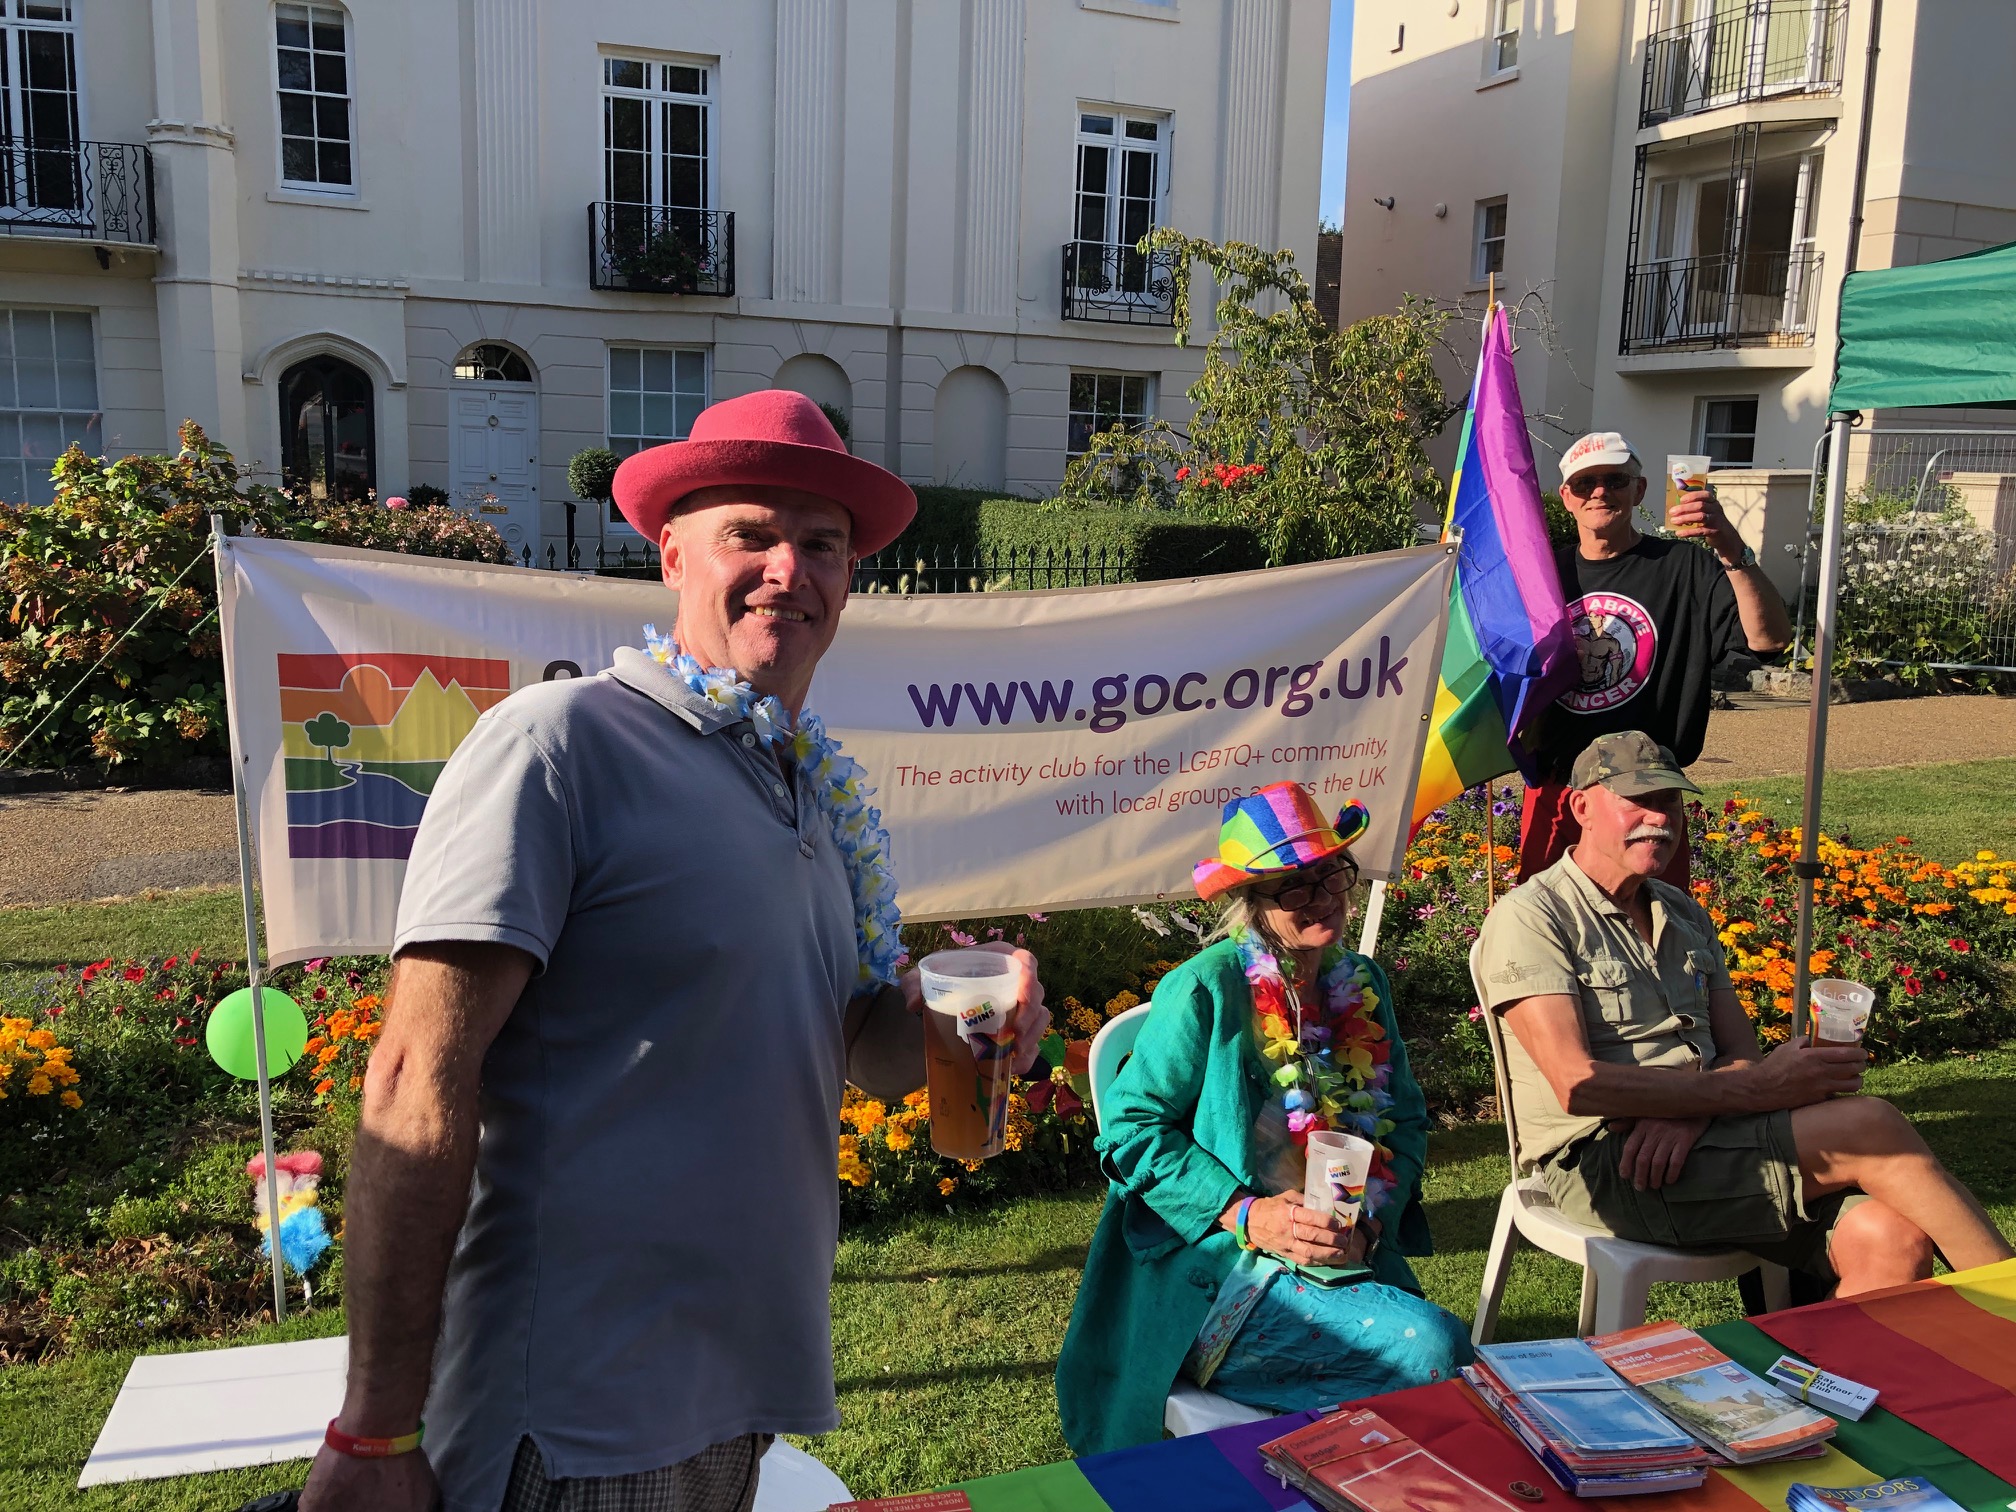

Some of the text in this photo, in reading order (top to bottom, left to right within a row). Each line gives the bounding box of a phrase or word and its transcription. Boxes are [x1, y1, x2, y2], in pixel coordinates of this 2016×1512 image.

[489, 392, 497, 401] 17
[1589, 598, 1650, 637] ABOVE
[907, 636, 1408, 733] www.goc.org.uk
[1561, 677, 1638, 708] ANCER
[896, 737, 1388, 787] The activity club for the LGBTQ+ community,
[1055, 790, 1104, 816] with
[1113, 788, 1164, 814] local
[1167, 786, 1242, 812] groups
[1324, 772, 1353, 794] the
[1358, 765, 1388, 788] UK
[960, 1001, 992, 1020] LOVE
[964, 1009, 995, 1027] WINS
[1328, 1164, 1349, 1173] LOVE
[1330, 1170, 1350, 1179] WINS
[1495, 1353, 1517, 1361] Isles
[1529, 1351, 1553, 1360] Scilly
[1692, 1346, 1707, 1354] Wye
[1611, 1352, 1652, 1366] Ashford
[1816, 1374, 1836, 1384] Gay
[1810, 1383, 1831, 1394] Club
[1813, 1379, 1853, 1396] Outdoor
[1349, 1412, 1377, 1427] OS
[1303, 1443, 1341, 1463] Cardigan
[1814, 1479, 1920, 1501] OUTDOORS
[873, 1491, 962, 1508] PLACES OF INTEREST
[882, 1503, 922, 1512] STREETS
[938, 1497, 964, 1506] INDEX
